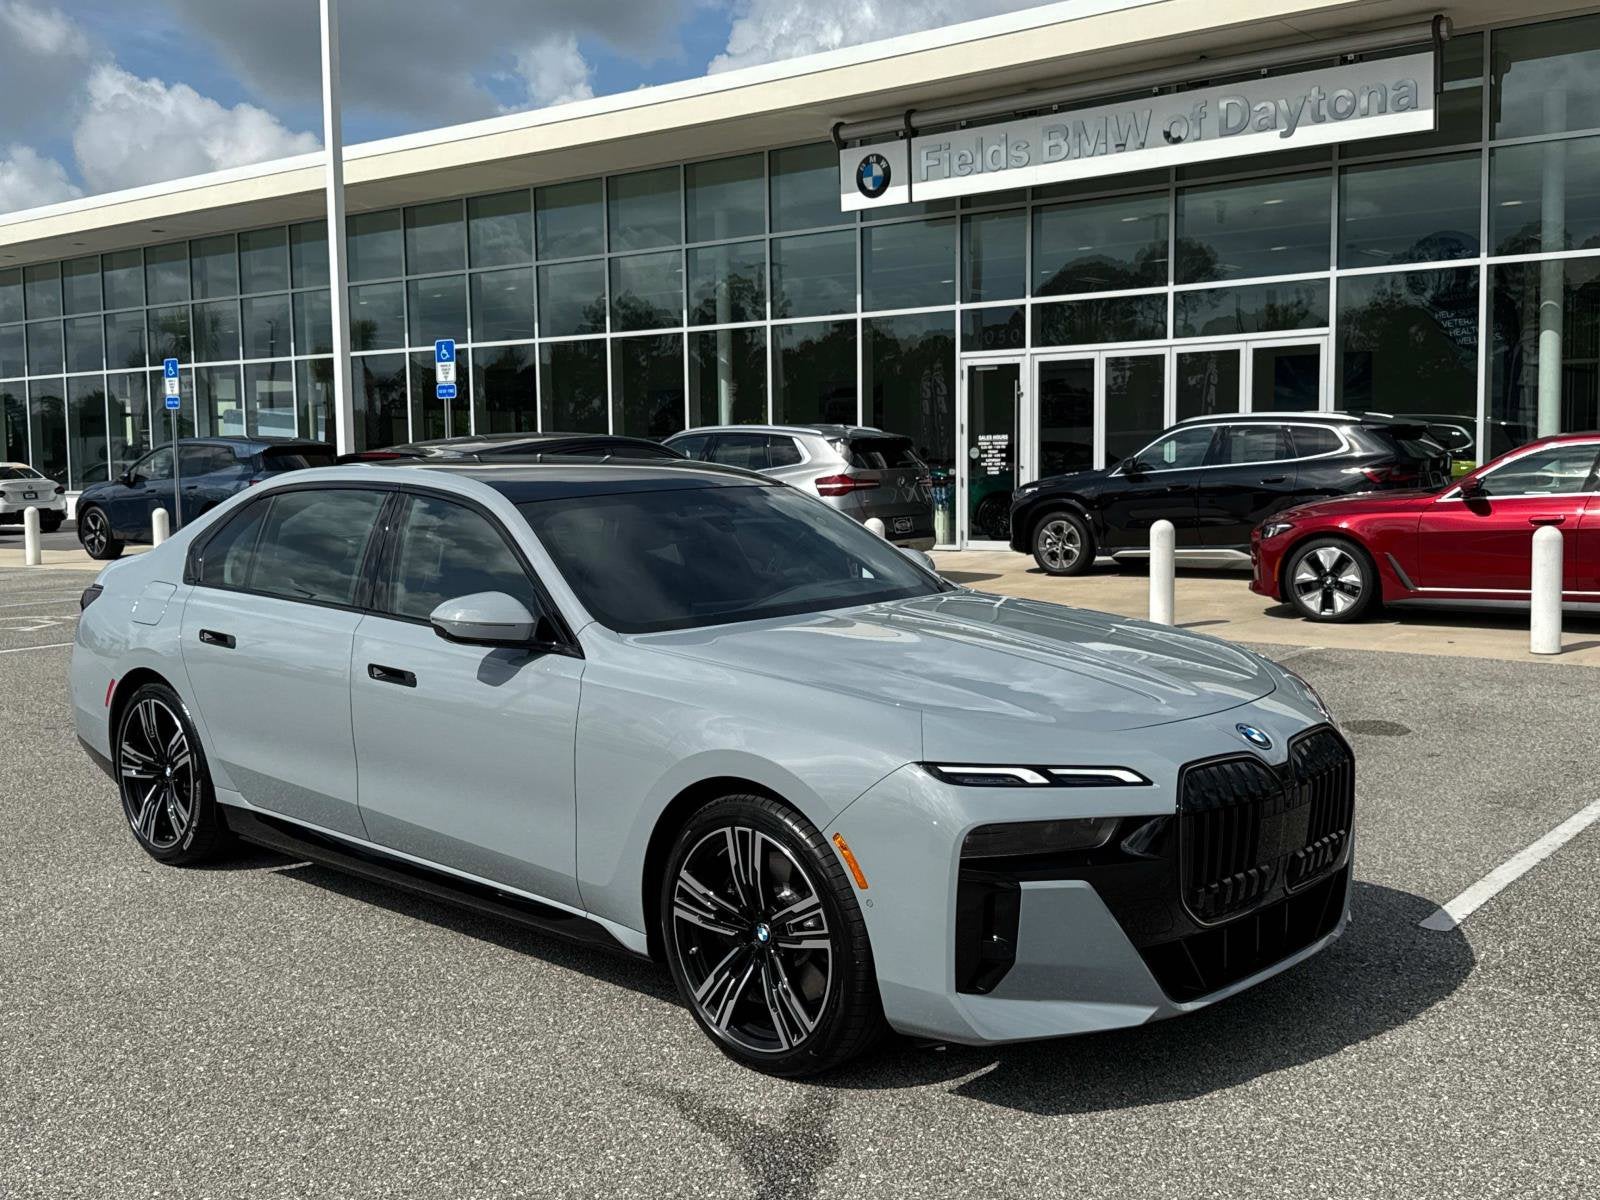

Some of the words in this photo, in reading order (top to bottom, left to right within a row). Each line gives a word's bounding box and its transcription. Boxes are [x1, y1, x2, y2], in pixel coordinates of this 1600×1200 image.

[920, 131, 1031, 181] Fields
[1040, 109, 1152, 163] BMW
[1162, 100, 1207, 144] of
[1218, 78, 1419, 138] Daytona
